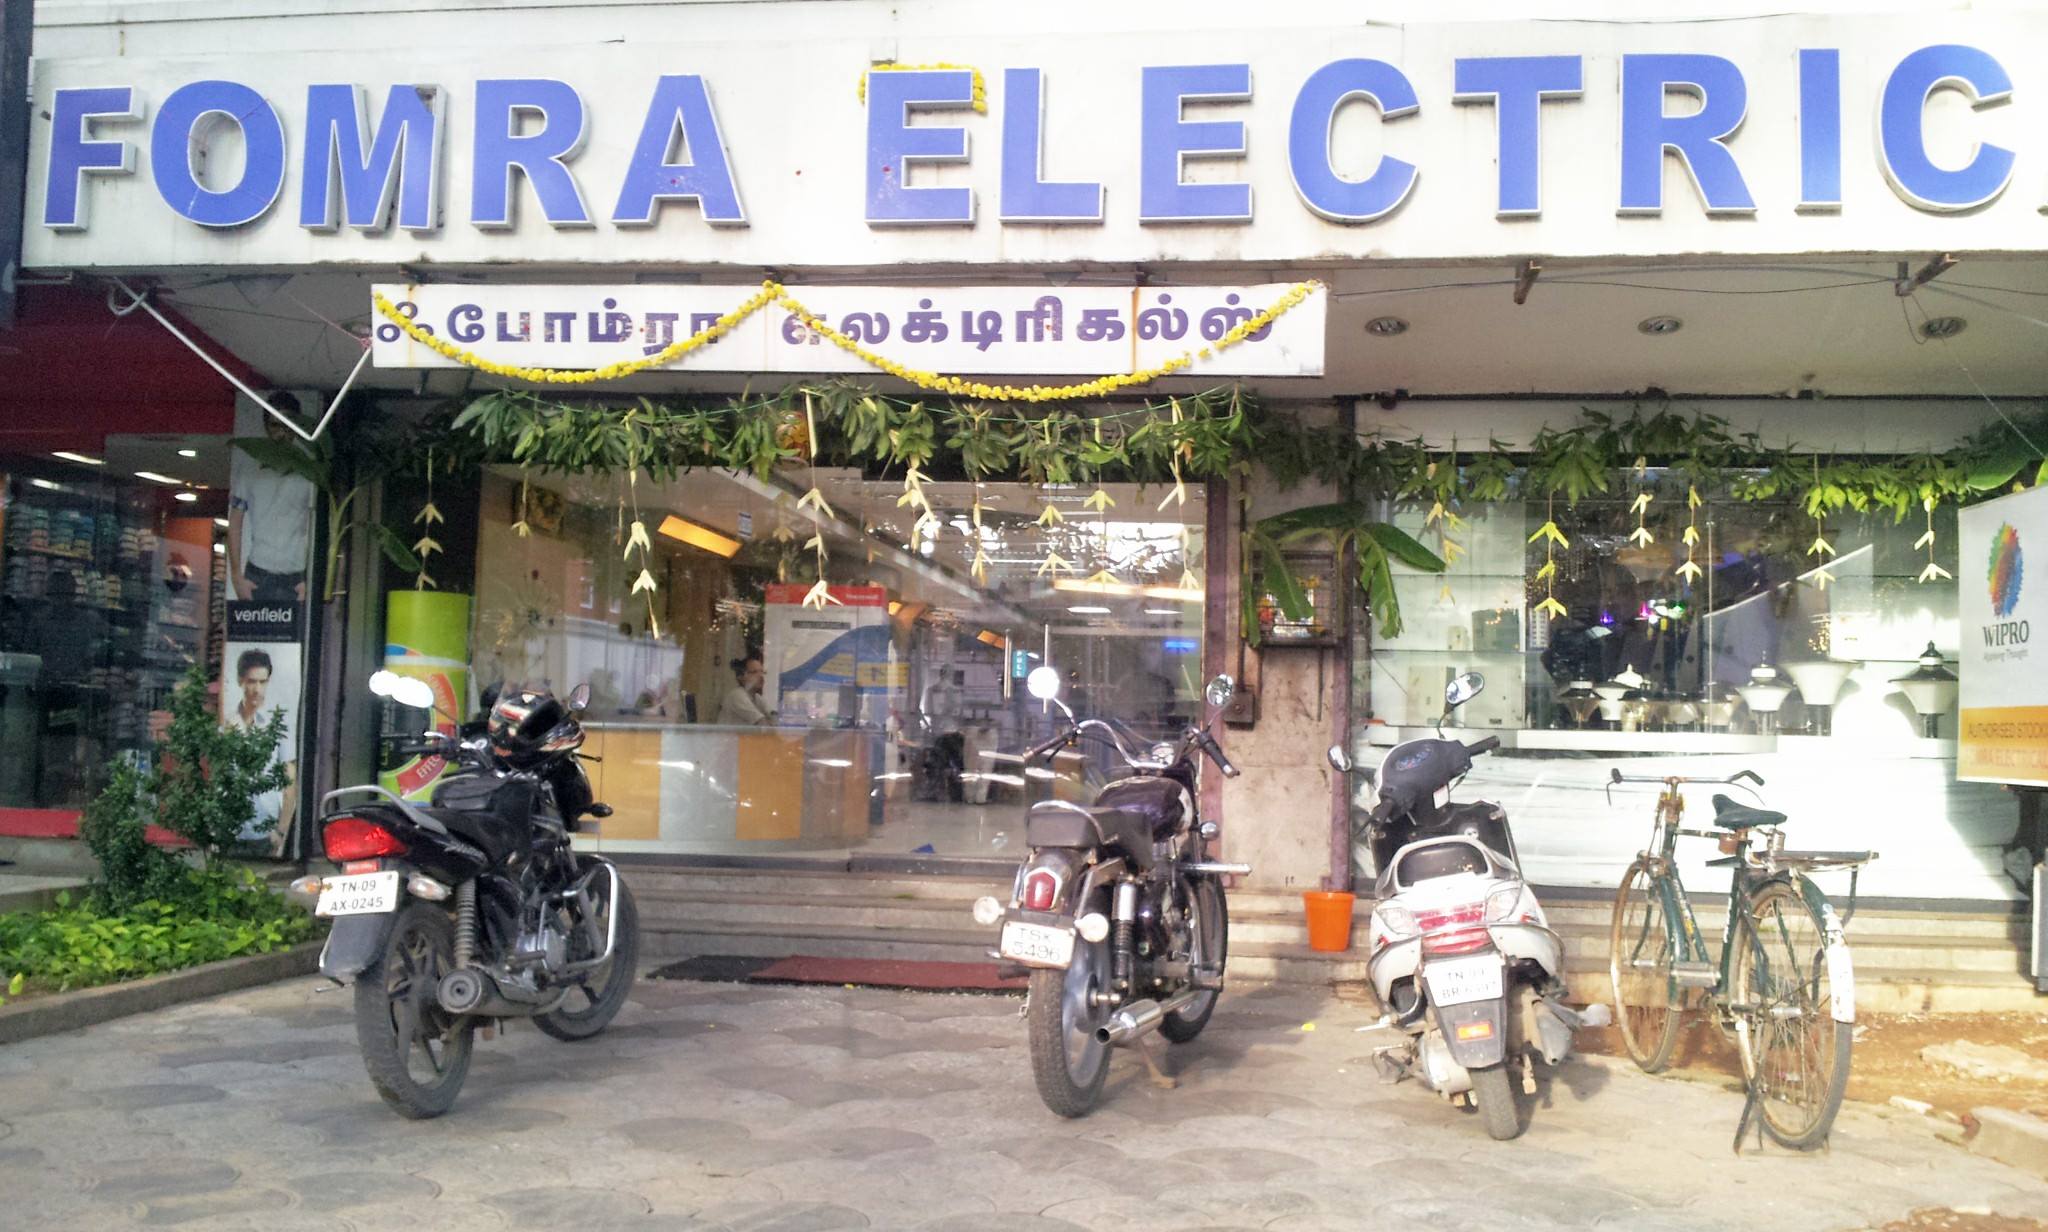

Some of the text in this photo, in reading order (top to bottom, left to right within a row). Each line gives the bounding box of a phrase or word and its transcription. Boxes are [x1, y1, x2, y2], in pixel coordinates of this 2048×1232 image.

[43, 44, 2048, 232] FOMRA ELECTRIC
[234, 607, 293, 622] venfield
[1982, 620, 2030, 647] WIPRO
[341, 880, 377, 893] TN-09
[330, 896, 384, 912] AX-0245
